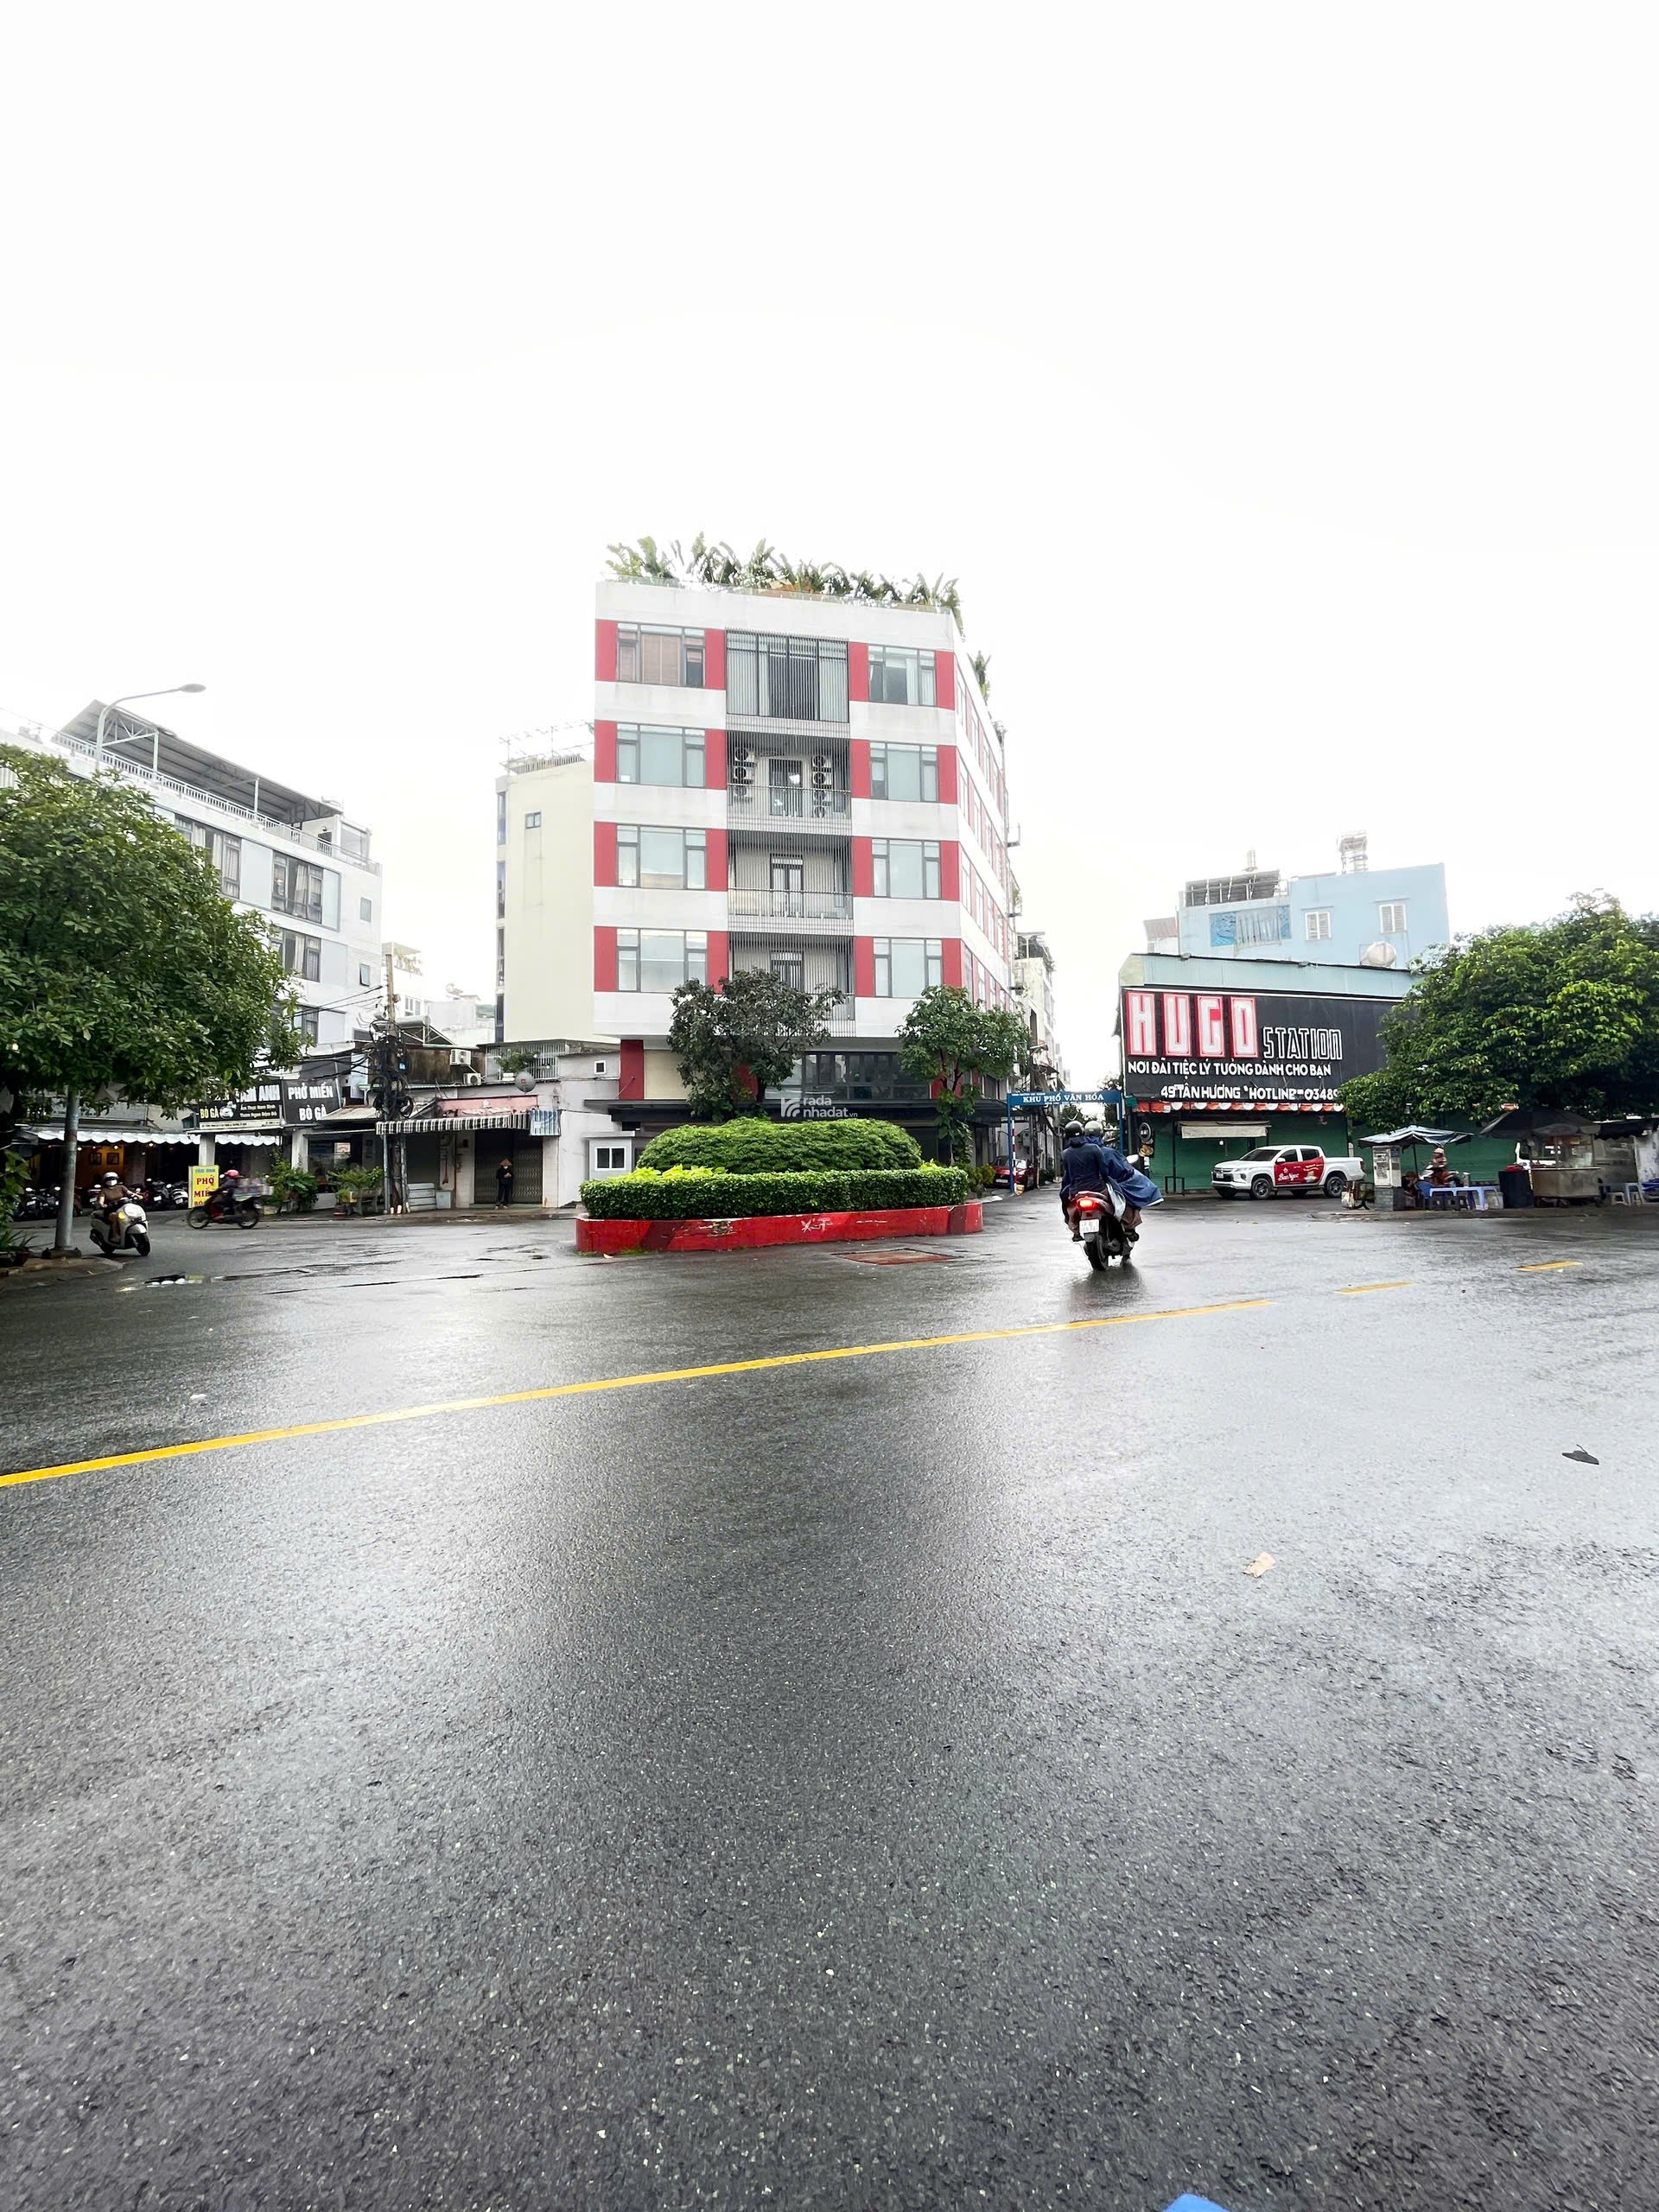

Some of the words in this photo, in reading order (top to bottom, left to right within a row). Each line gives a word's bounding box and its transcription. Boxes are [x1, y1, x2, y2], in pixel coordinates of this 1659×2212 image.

[1126, 992, 1258, 1058] HUGO
[1263, 1027, 1343, 1060] STATION
[1151, 1057, 1171, 1075] ĐÃI
[1173, 1058, 1198, 1080] TIỆC
[1199, 1058, 1211, 1076] LÝ
[1255, 1060, 1284, 1076] DÀNH
[1285, 1064, 1309, 1077] CHO
[1310, 1064, 1332, 1079] BẠN
[288, 1083, 308, 1100] PHỞ
[308, 1082, 334, 1099] MIẾN
[1044, 1092, 1062, 1102] PHỐ
[1084, 1092, 1105, 1101] HÓA
[1160, 1085, 1175, 1099] 49
[1249, 1087, 1297, 1101] HOTLINE
[298, 1104, 313, 1122] BÒ
[314, 1103, 327, 1122] GÀ
